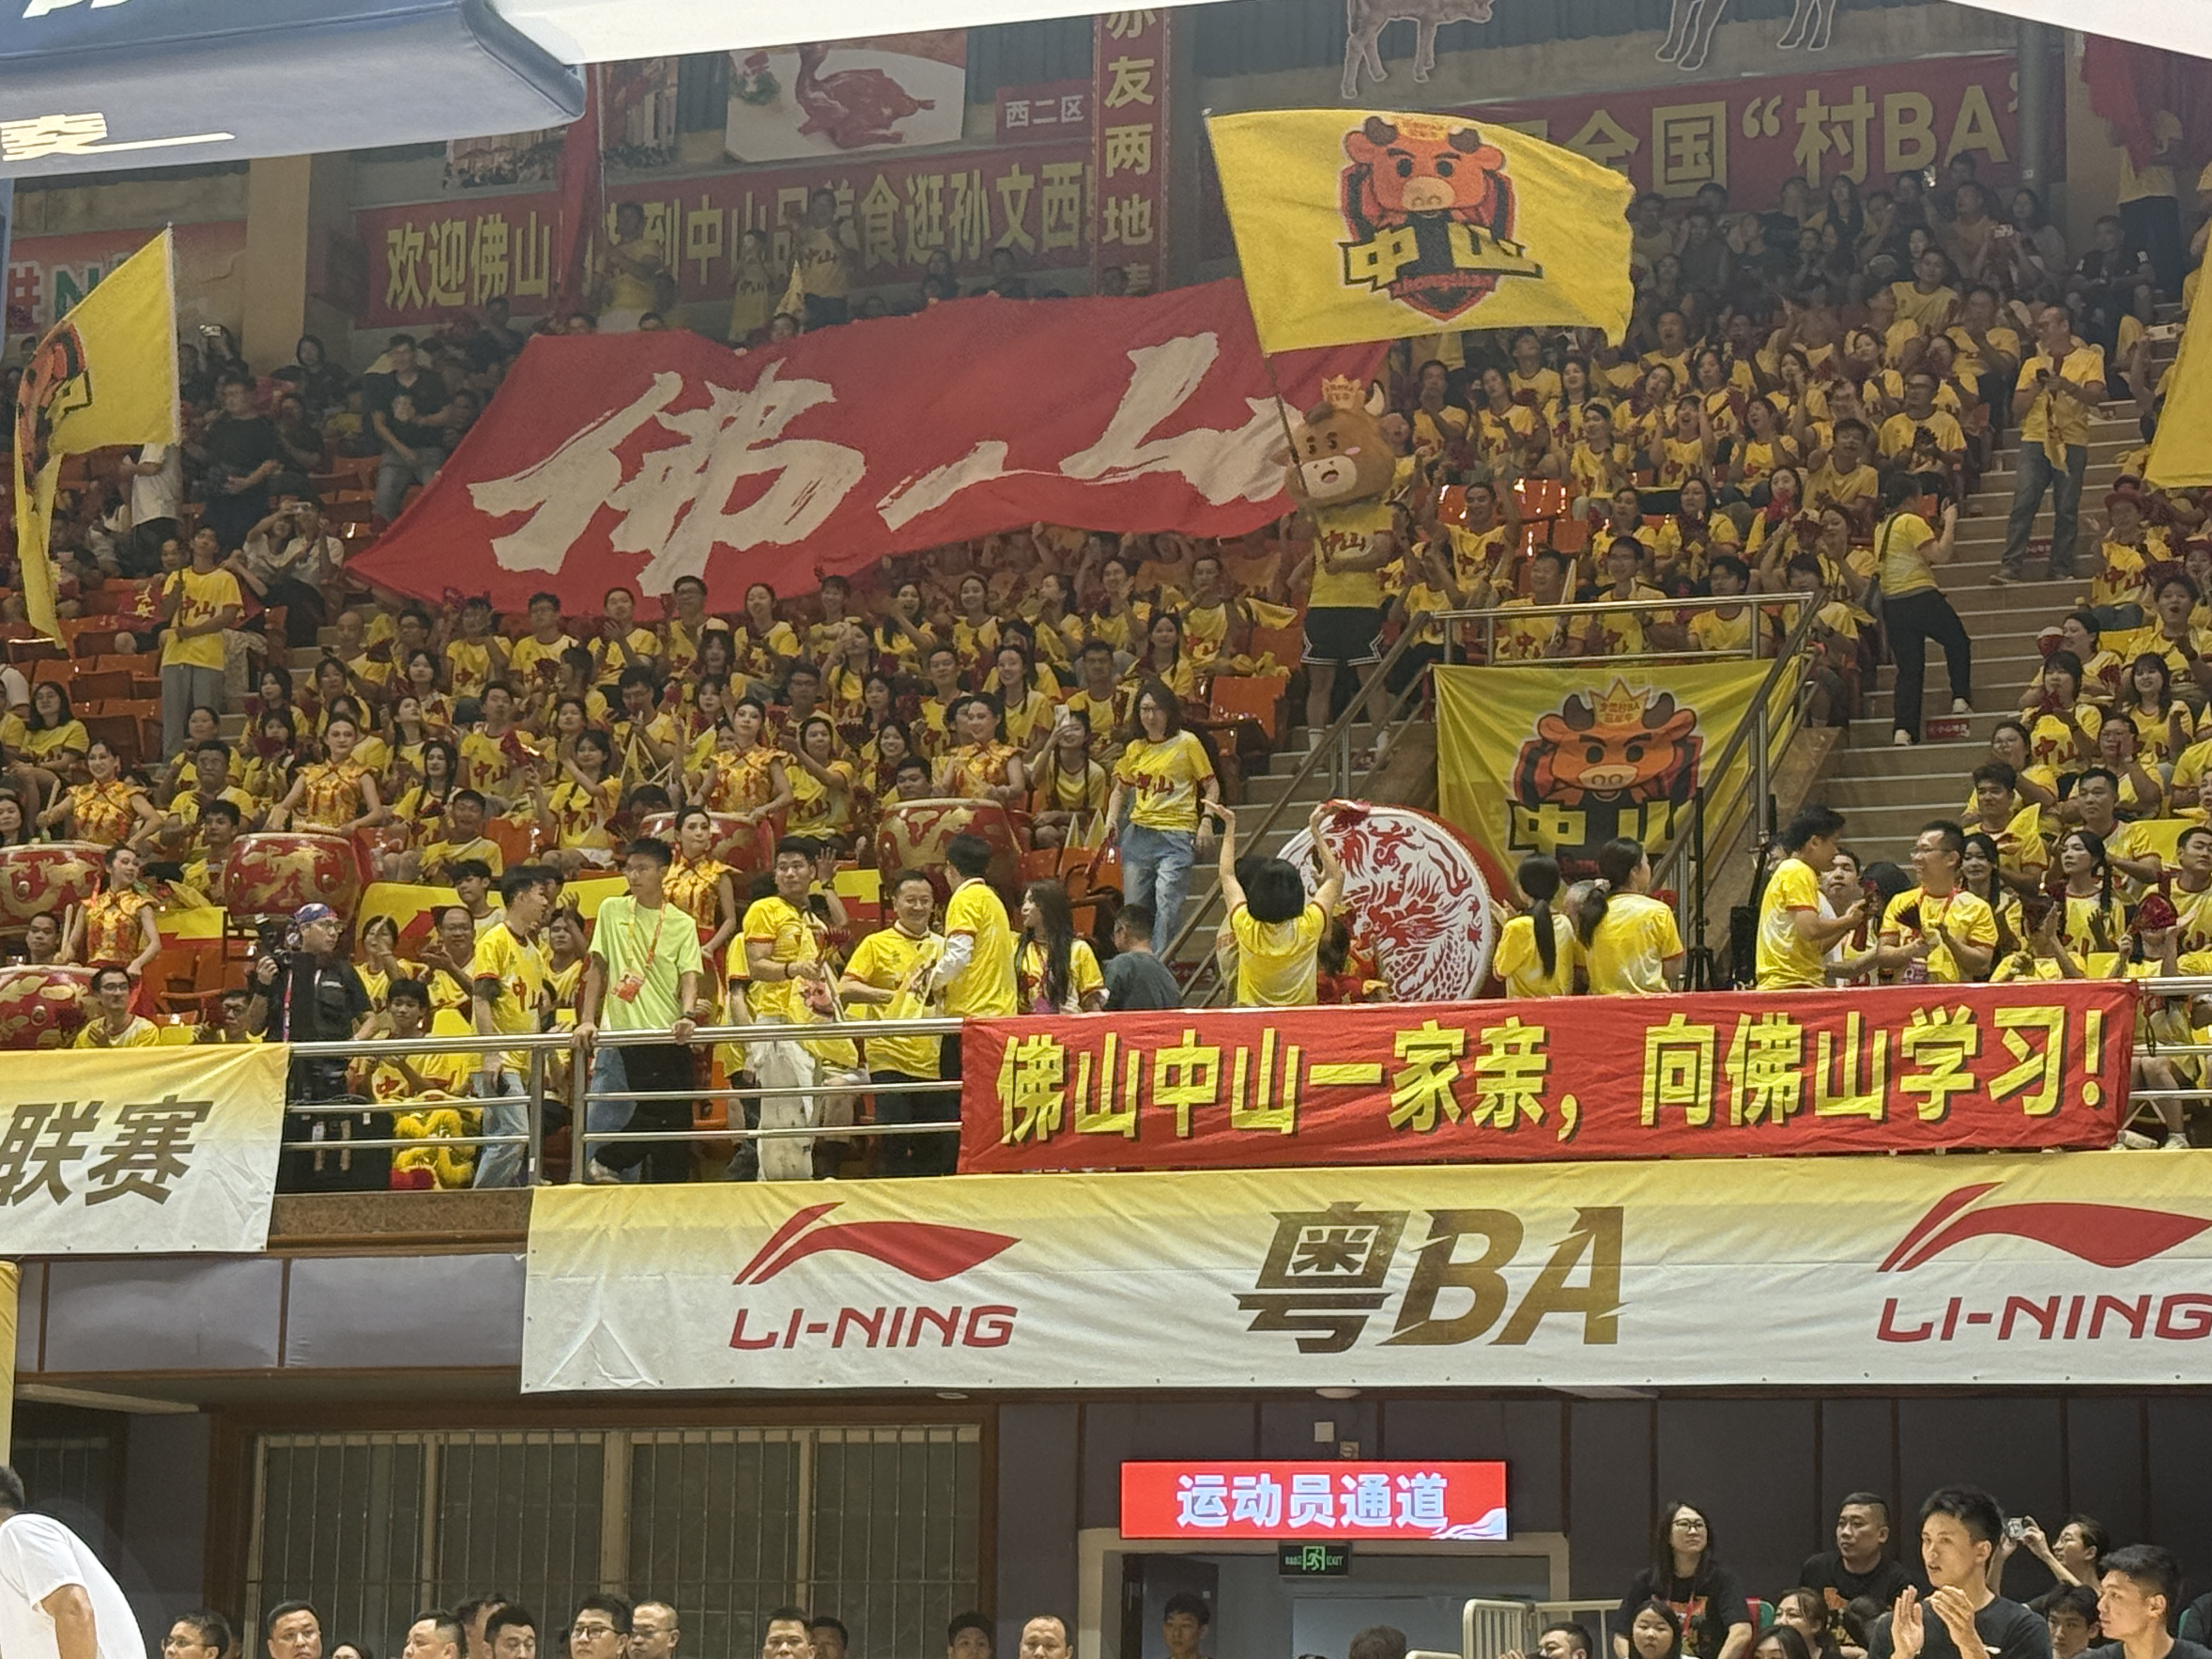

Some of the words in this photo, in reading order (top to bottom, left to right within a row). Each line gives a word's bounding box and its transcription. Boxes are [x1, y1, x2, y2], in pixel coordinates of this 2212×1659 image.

[1004, 95, 1085, 129] 西二区
[1343, 222, 1541, 290] 中山
[0, 1094, 214, 1207] 联赛
[1231, 1201, 1630, 1355] 粤BA
[729, 1305, 1018, 1350] LI-NING
[1877, 1293, 2212, 1342] LI-NING
[1176, 1472, 1448, 1528] 运动员通道
